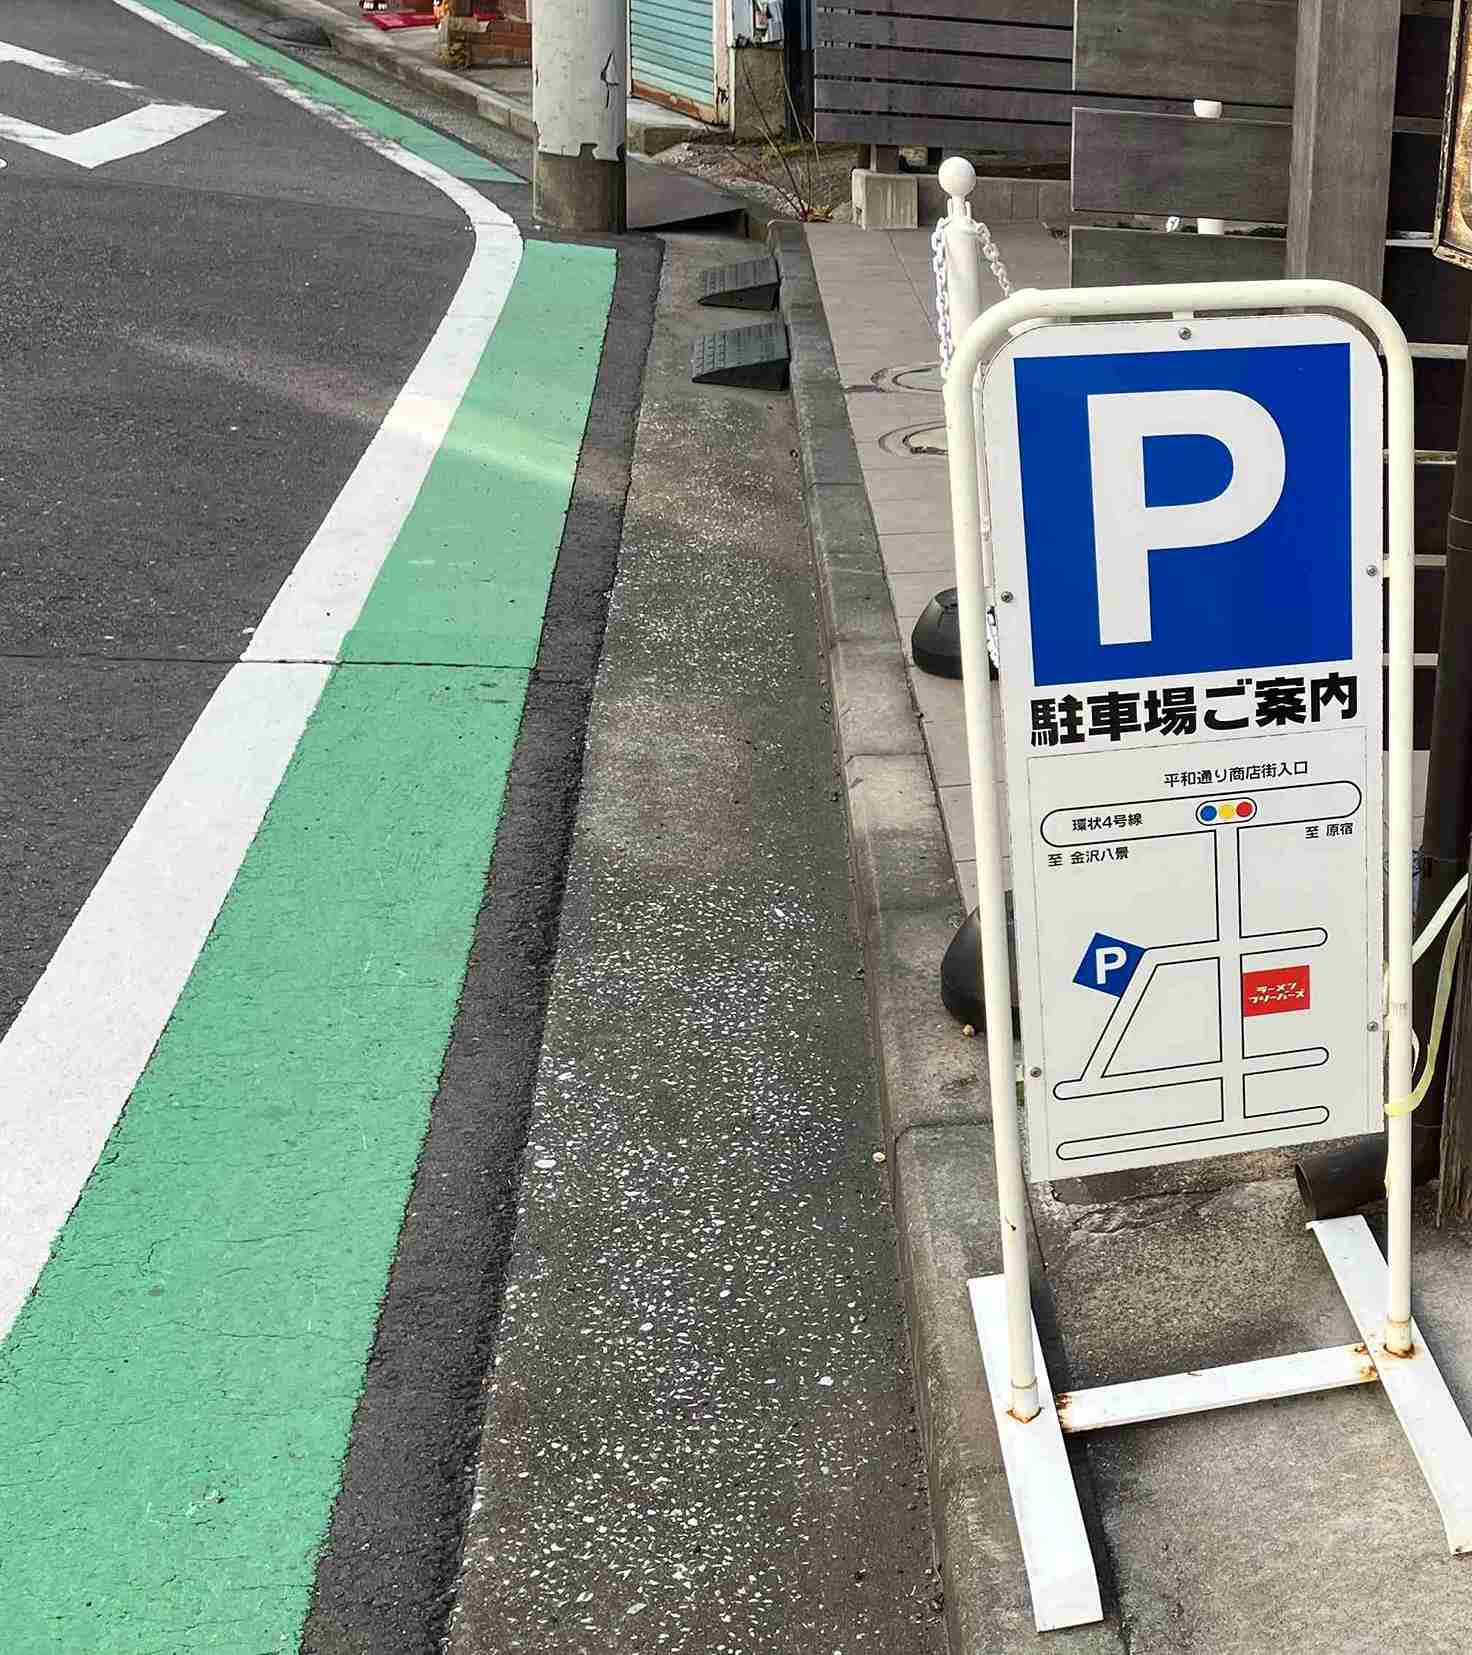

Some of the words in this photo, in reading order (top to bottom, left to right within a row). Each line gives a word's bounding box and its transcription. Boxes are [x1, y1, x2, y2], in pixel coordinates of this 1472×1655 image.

[1087, 389, 1286, 646] P
[1030, 672, 1358, 747] 駐車場ご案内
[1163, 760, 1309, 788] 平和通り商店街入口
[1071, 812, 1144, 832] 環状4号線
[1305, 826, 1320, 840] 至
[1326, 823, 1354, 838] 原宿
[1047, 853, 1063, 868] 至
[1070, 847, 1130, 866] 金沢八景
[1095, 946, 1128, 985] P
